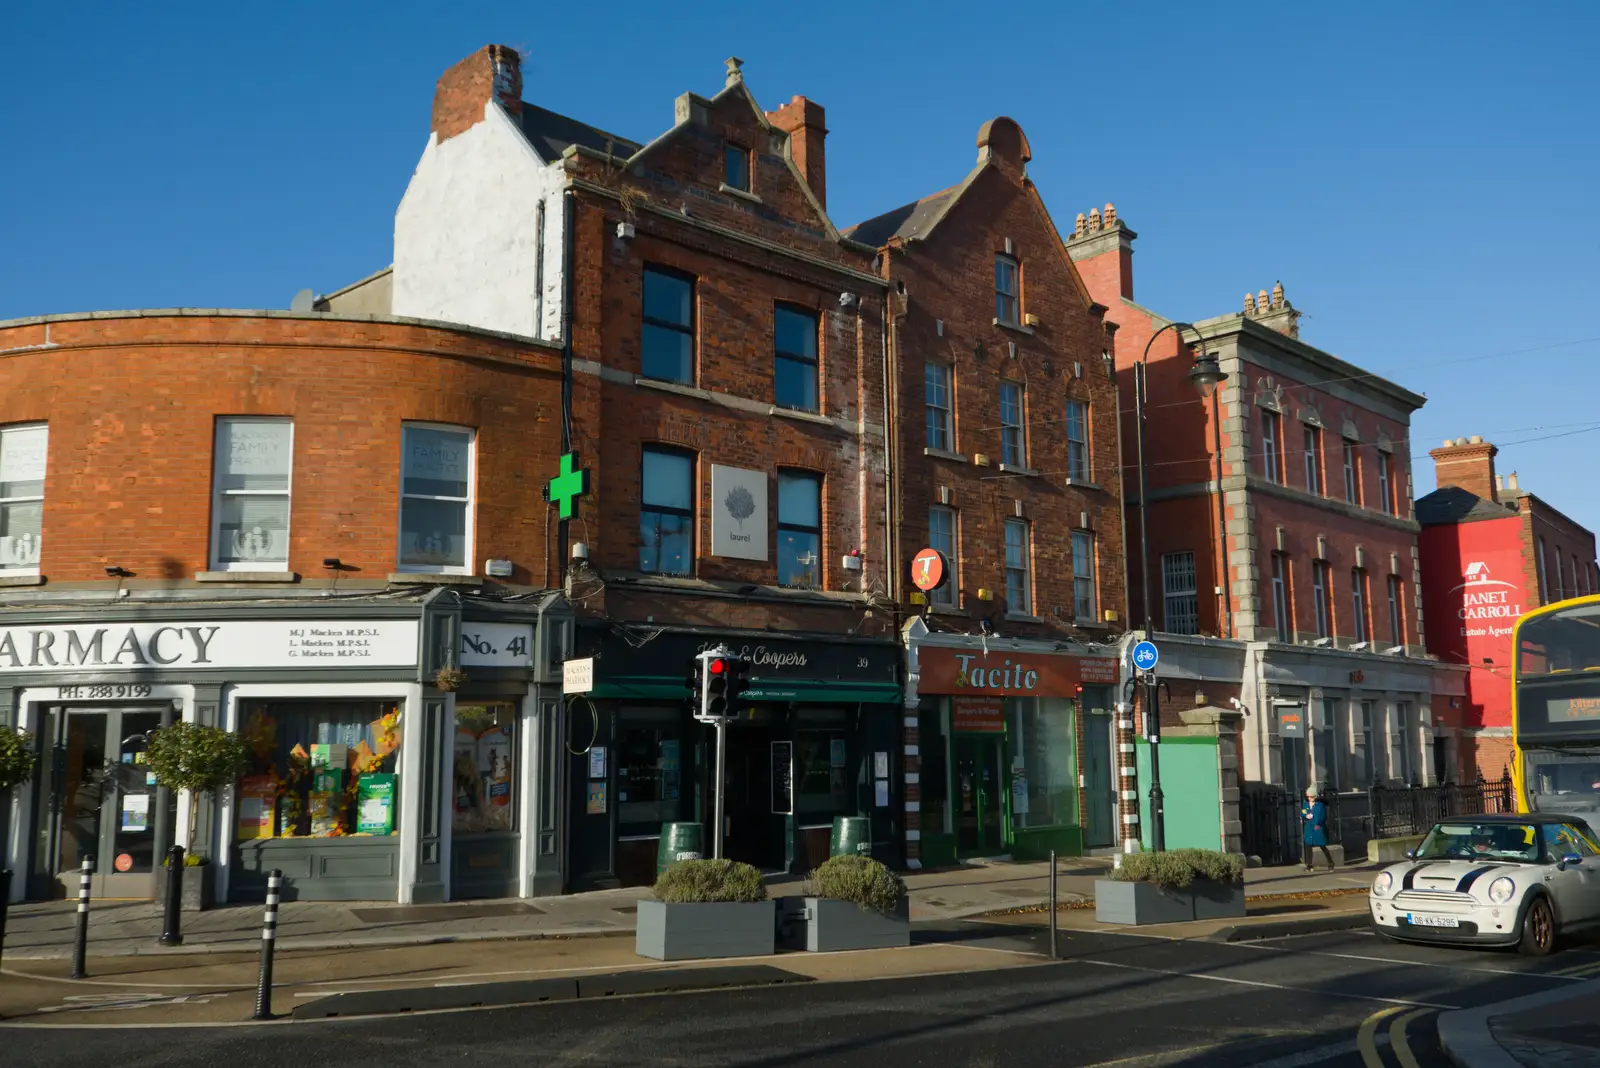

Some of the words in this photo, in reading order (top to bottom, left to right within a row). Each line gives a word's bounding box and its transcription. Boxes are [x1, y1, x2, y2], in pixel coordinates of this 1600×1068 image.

[230, 441, 279, 454] FAMILY
[413, 445, 460, 462] FAMILY
[730, 531, 751, 543] laurel
[1463, 591, 1508, 607] JANET
[1458, 604, 1523, 620] CARROLL
[309, 628, 343, 636] Macken
[1460, 627, 1486, 637] Estate
[301, 639, 334, 647] Macken
[460, 634, 498, 655] No.
[505, 636, 528, 657] 41
[301, 649, 334, 657] Macken
[753, 645, 808, 669] Coopers
[857, 657, 868, 668] 39
[955, 654, 1039, 689] Tacito
[58, 687, 83, 699] PH:
[88, 686, 113, 698] 288
[117, 684, 151, 697] 9199
